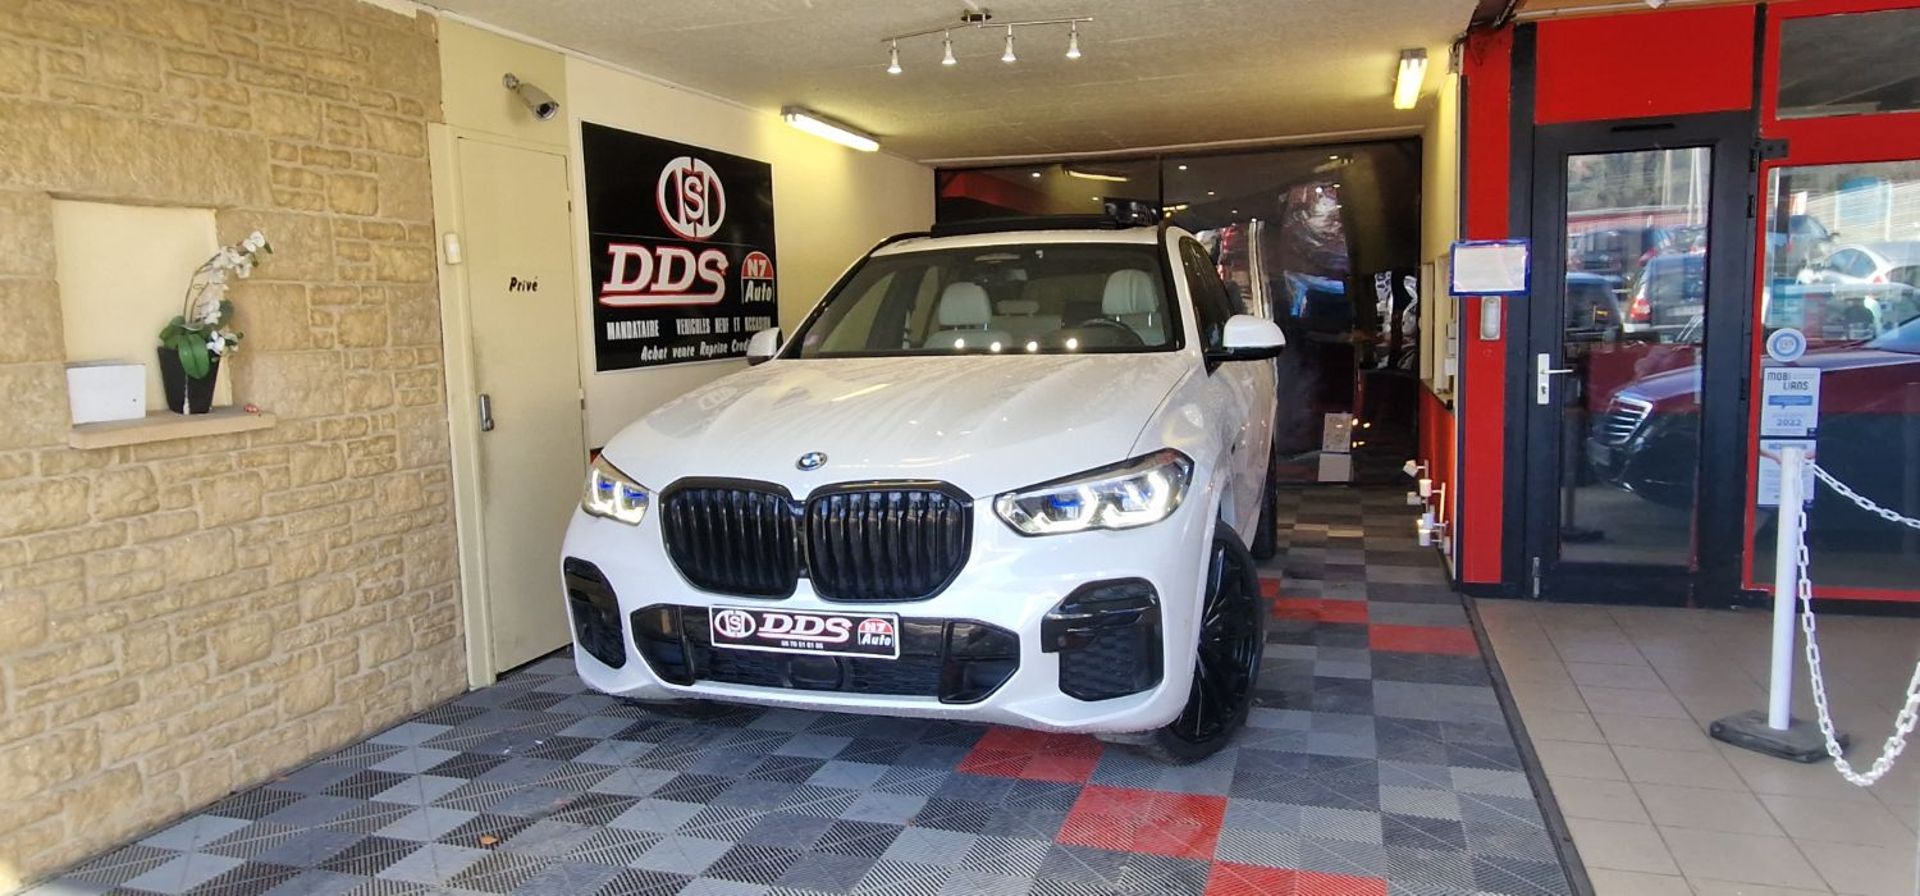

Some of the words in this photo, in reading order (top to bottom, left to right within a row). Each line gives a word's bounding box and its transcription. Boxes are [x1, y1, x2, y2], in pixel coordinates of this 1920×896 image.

[599, 243, 729, 308] DDS
[747, 258, 767, 277] N7
[508, 275, 539, 293] Privé
[744, 279, 773, 303] Auto
[606, 319, 660, 341] MANDATAIRE
[675, 317, 711, 336] VEHICULES
[714, 316, 729, 334] NEUF
[733, 316, 741, 332] ET
[640, 343, 668, 362] Achat
[672, 345, 695, 359] vente
[700, 340, 728, 358] Reprise
[731, 338, 751, 353] Cred
[757, 613, 853, 643] DDS
[864, 622, 886, 632] N7
[861, 633, 892, 647] Auto
